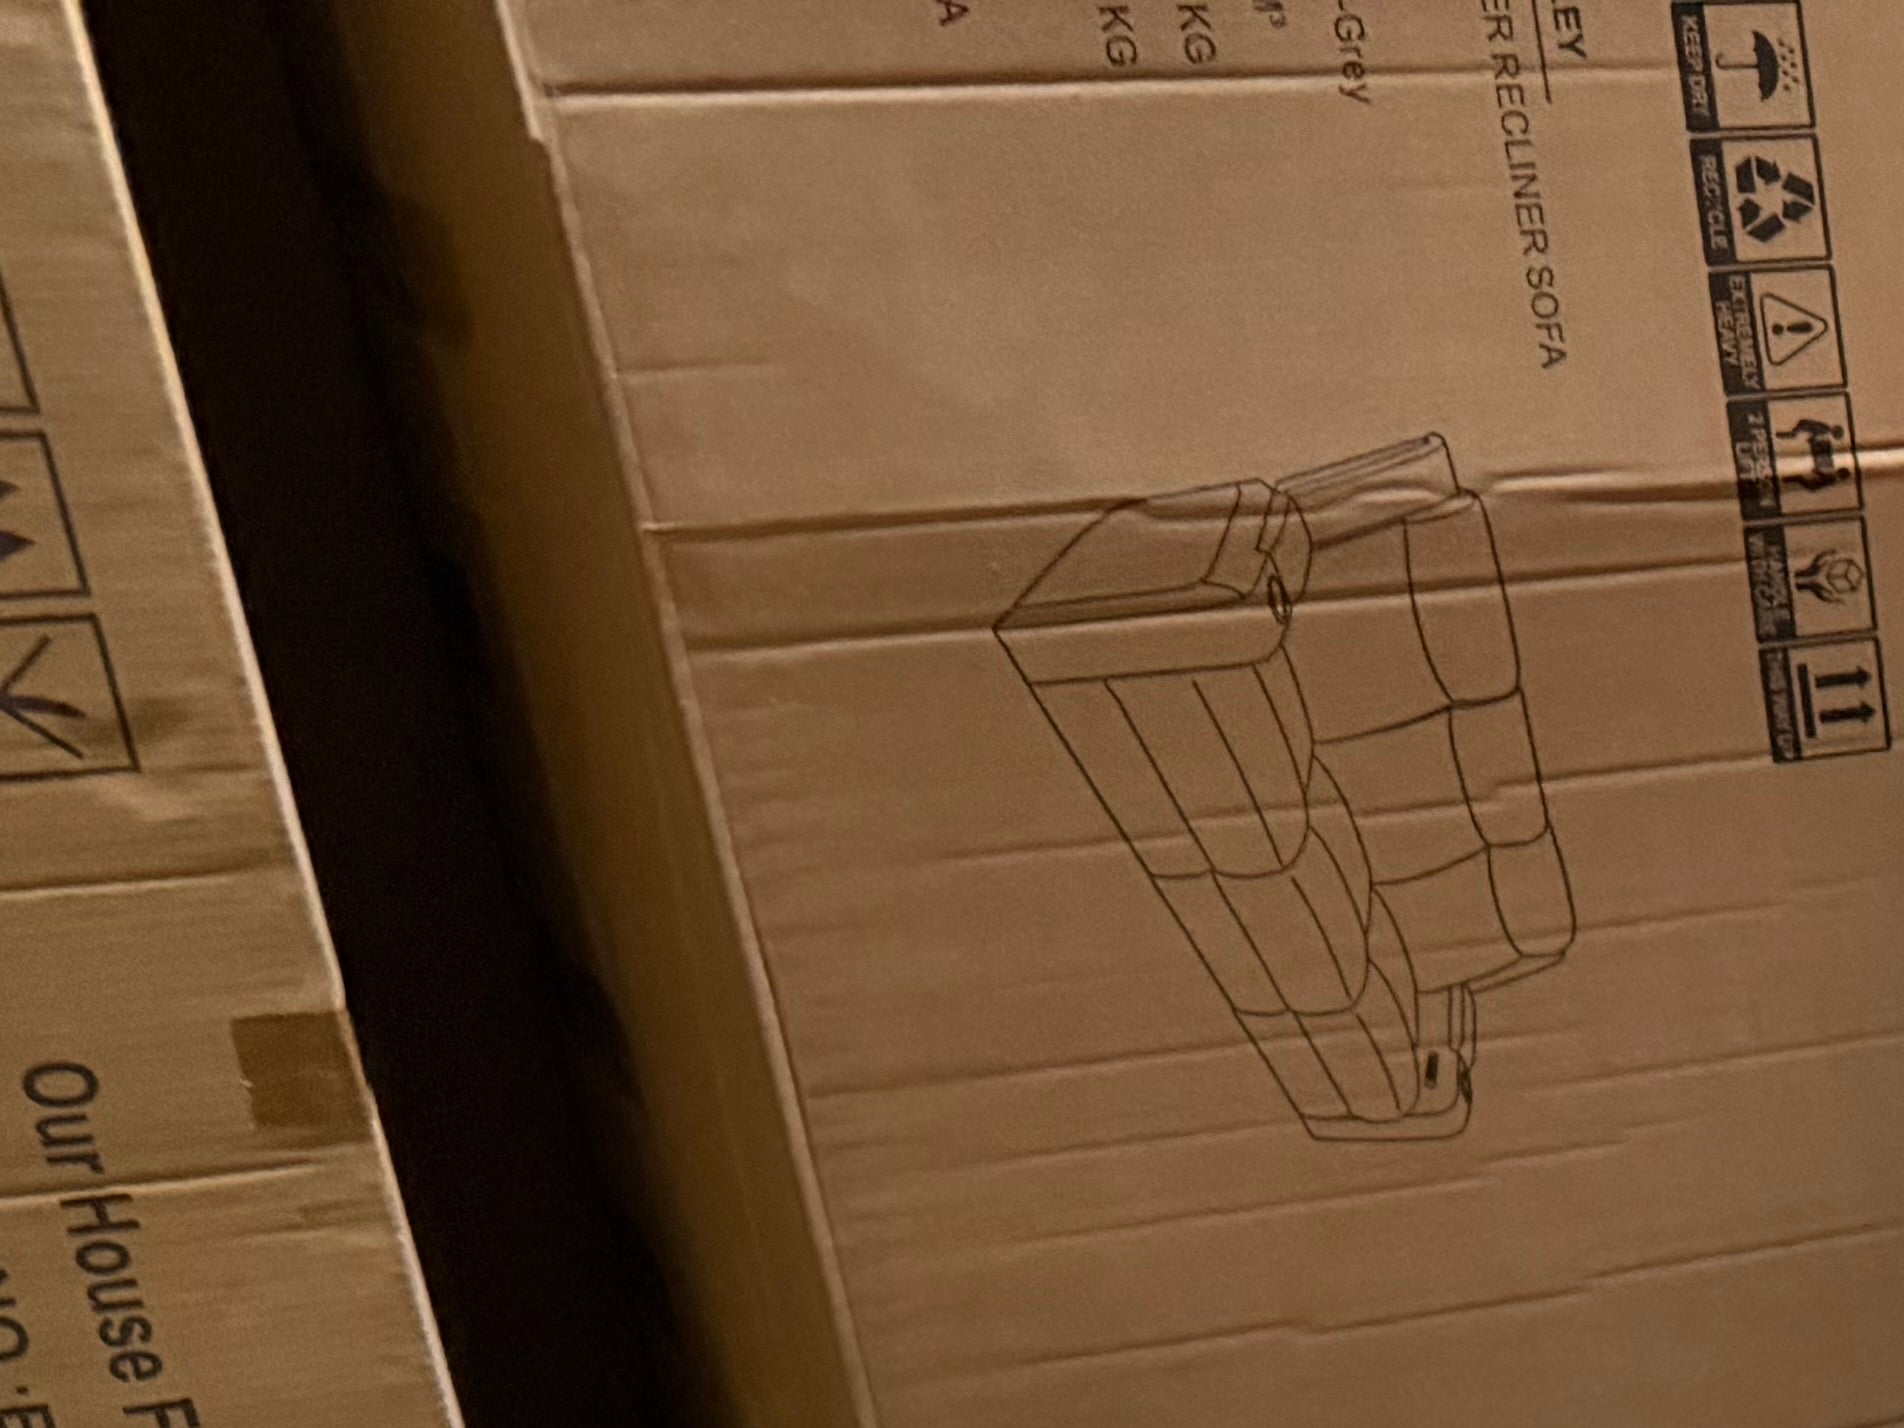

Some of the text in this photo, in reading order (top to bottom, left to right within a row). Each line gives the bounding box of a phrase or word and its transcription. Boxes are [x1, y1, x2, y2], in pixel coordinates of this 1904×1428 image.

[1099, 4, 1138, 68] KG
[1177, 4, 1217, 66] KG
[1552, 0, 1588, 59] EY
[1677, 15, 1704, 73] KEEP
[1490, 52, 1548, 256] RECLINER
[1525, 263, 1569, 370] SOFA
[1714, 299, 1739, 367] HEAVY
[1729, 274, 1760, 389] EXTREMELY
[21, 1060, 104, 1176] Our
[58, 1193, 164, 1385] House
